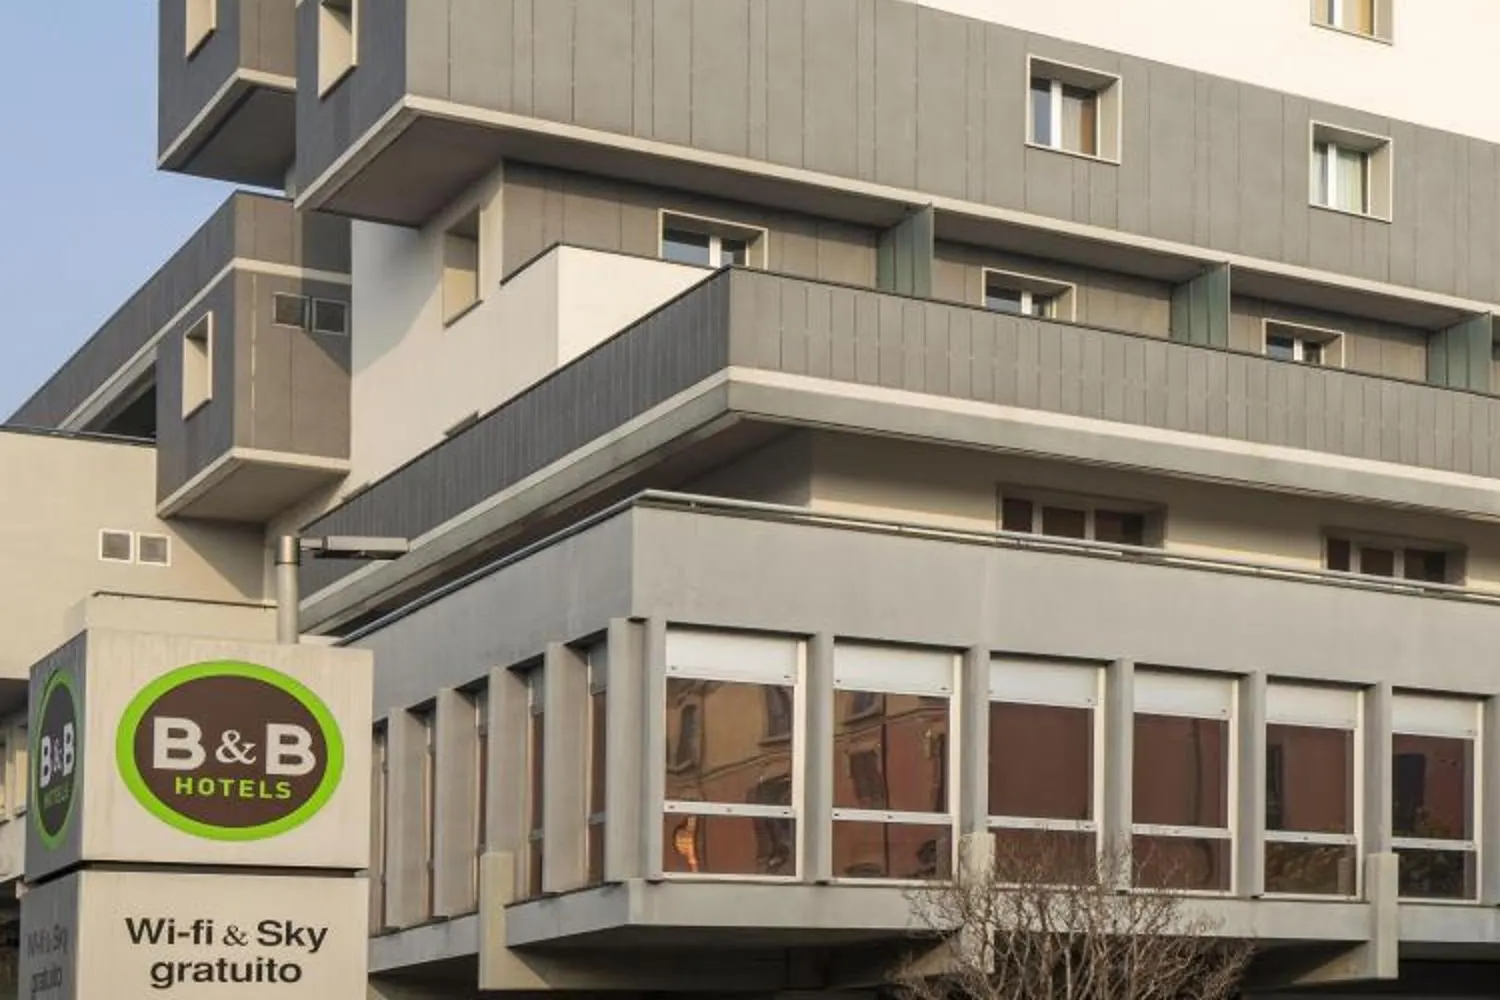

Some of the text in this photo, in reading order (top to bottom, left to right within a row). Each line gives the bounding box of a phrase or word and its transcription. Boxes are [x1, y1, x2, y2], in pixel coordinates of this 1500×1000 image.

[152, 716, 317, 777] B&B
[174, 776, 292, 800] HOTELS
[124, 917, 329, 954] Wi-fi & Sky
[149, 957, 303, 989] gratuito
